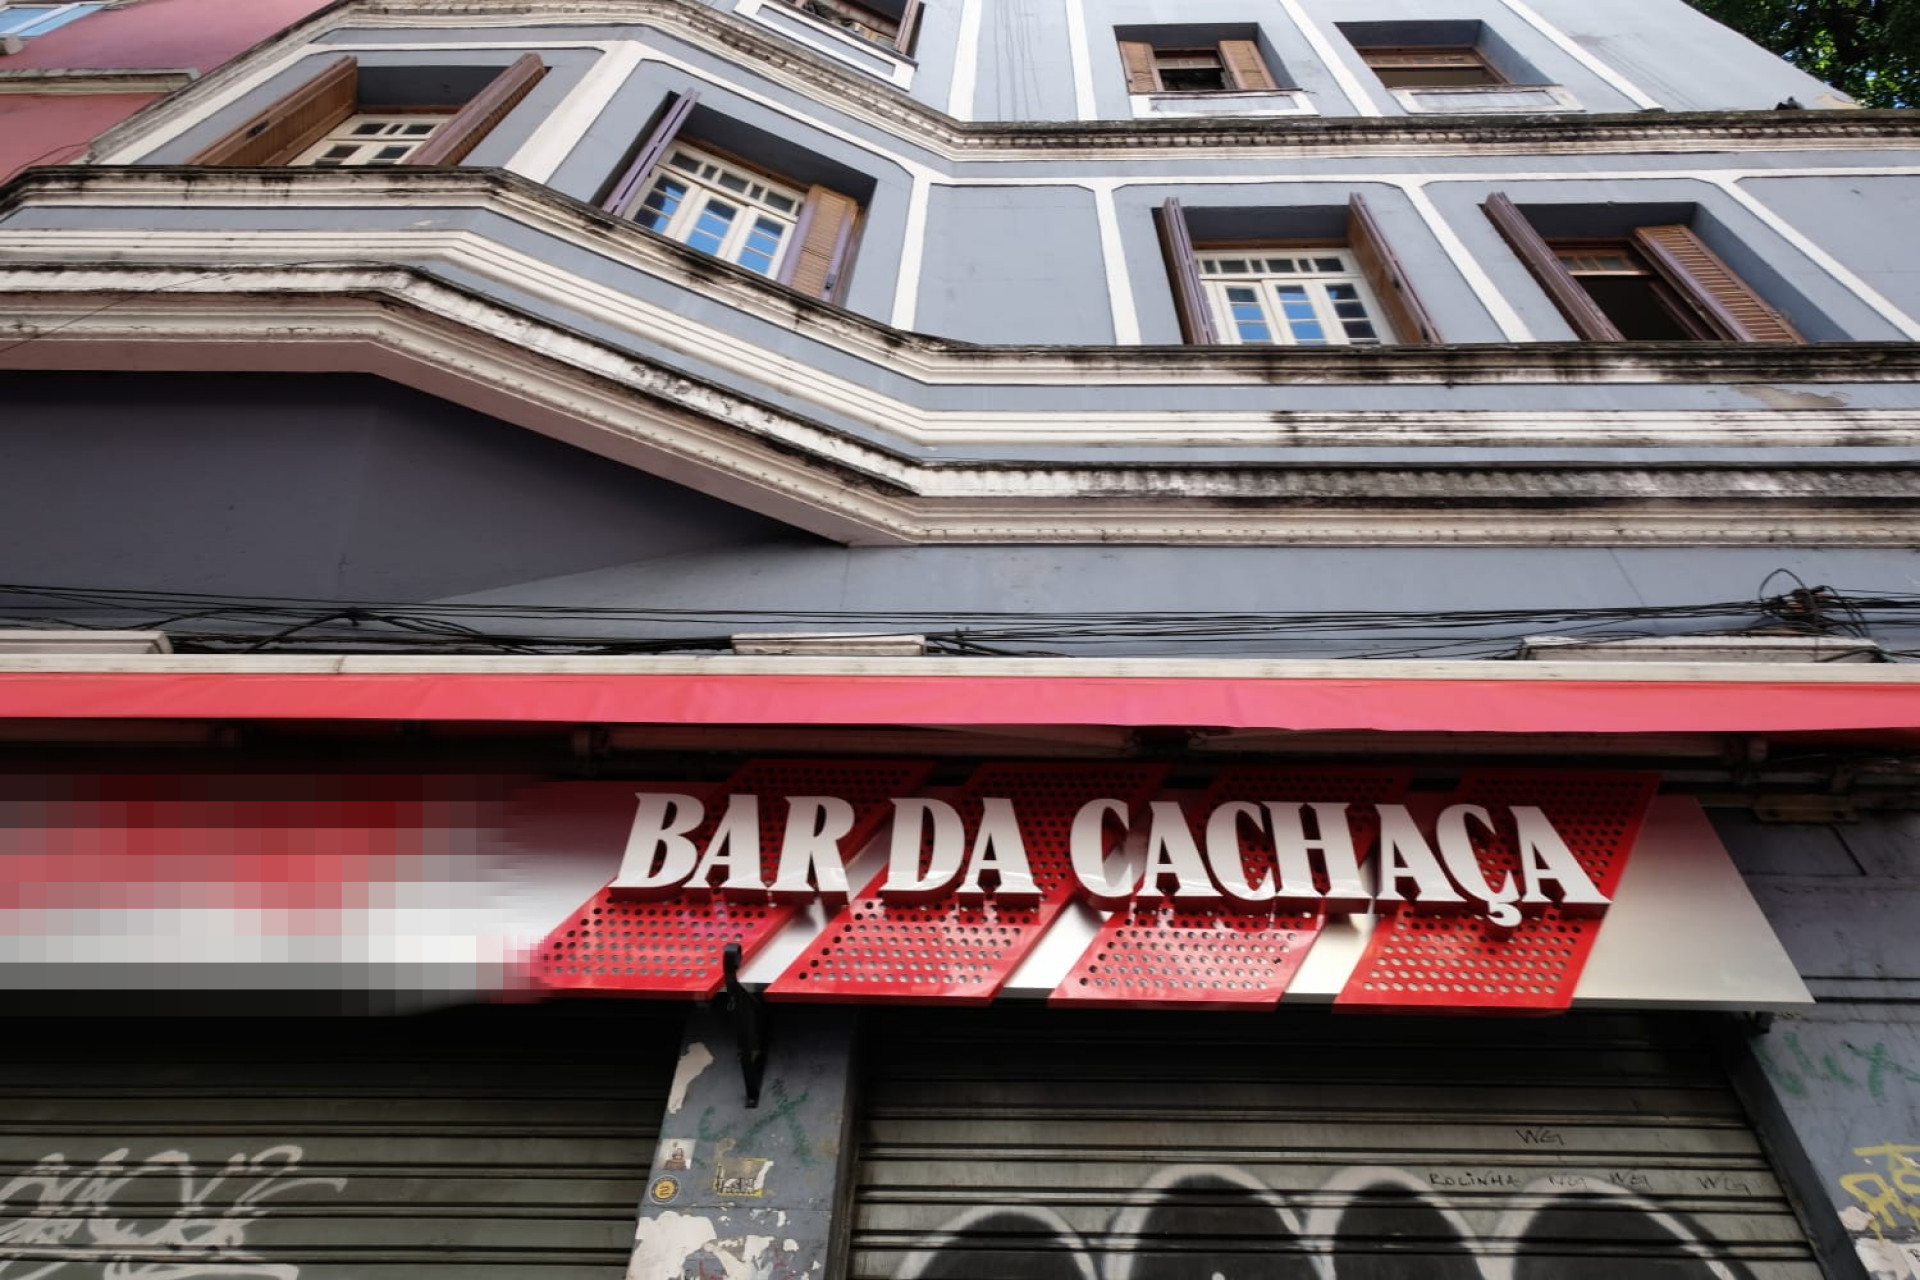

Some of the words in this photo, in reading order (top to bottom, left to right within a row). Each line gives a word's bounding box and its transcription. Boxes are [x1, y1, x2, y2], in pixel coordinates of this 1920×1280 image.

[607, 792, 854, 894] BAR
[880, 797, 1041, 894] DA
[1069, 798, 1613, 927] CACHAÇA
